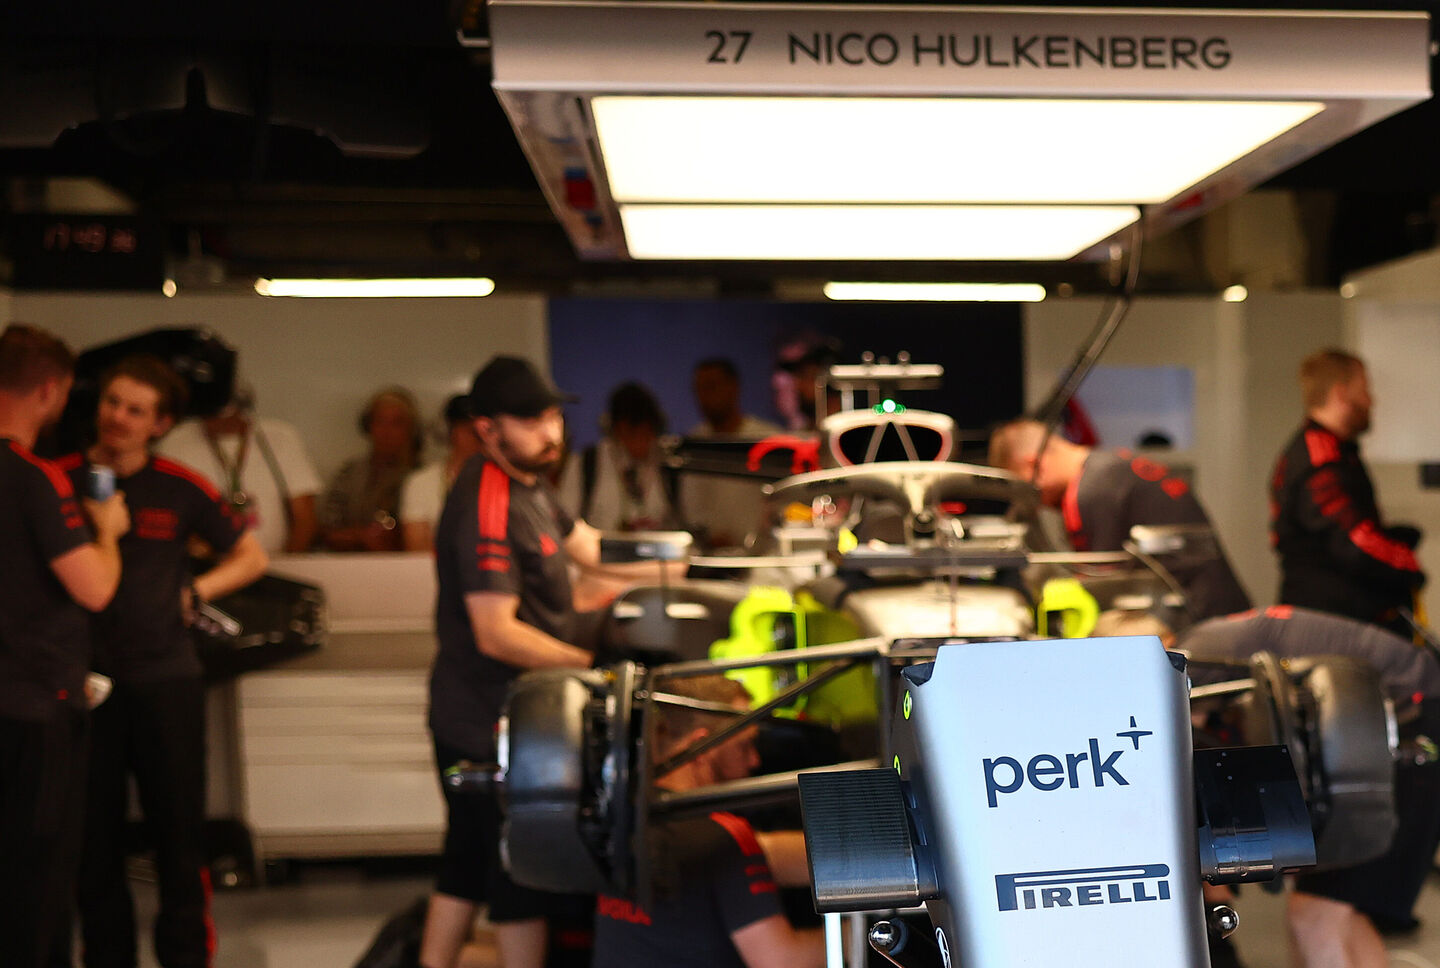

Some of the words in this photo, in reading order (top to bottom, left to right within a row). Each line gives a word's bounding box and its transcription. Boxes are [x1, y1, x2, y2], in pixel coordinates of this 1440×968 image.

[706, 31, 753, 63] 27
[788, 33, 898, 65] NICO
[913, 34, 1231, 69] HULKENBERG
[995, 863, 1171, 912] PIRELLI
